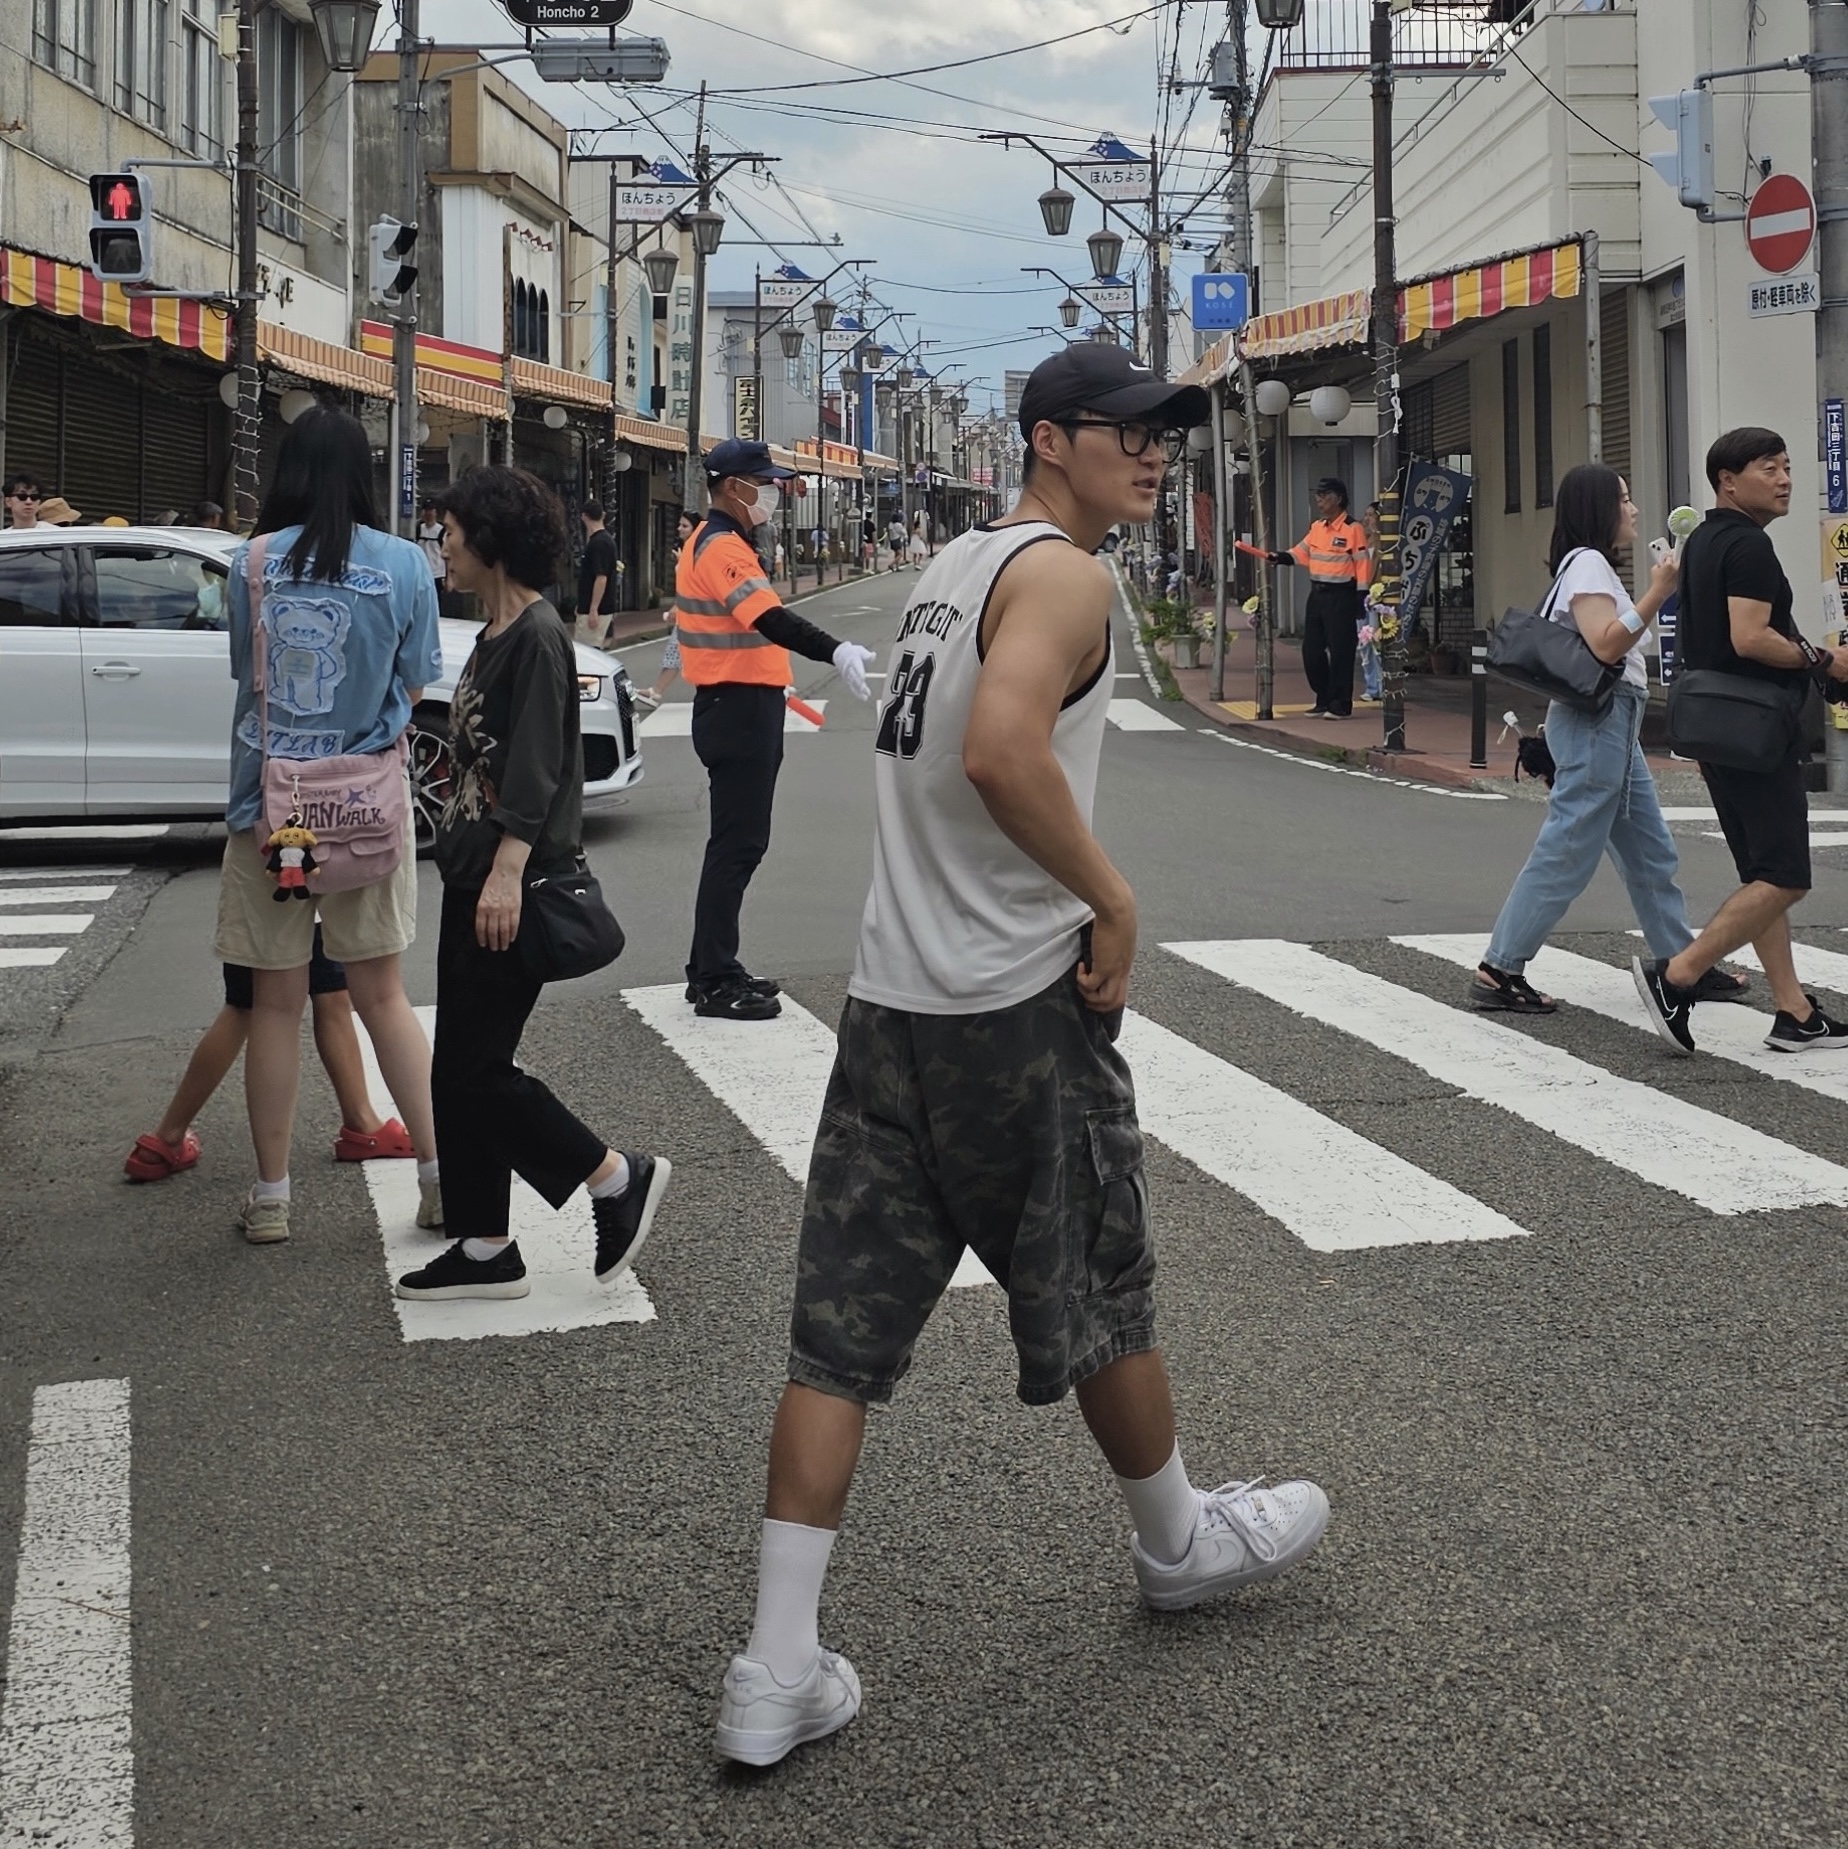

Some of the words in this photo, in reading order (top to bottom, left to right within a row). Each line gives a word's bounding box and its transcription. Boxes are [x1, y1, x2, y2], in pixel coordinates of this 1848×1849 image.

[537, 5, 586, 18] Honcho
[590, 5, 600, 18] 2
[1090, 168, 1146, 184] ほんちょう
[621, 191, 676, 205] ほんちょう
[763, 286, 802, 296] ほんちょう
[1093, 291, 1129, 301] ほんちょう
[1832, 475, 1840, 486] 6
